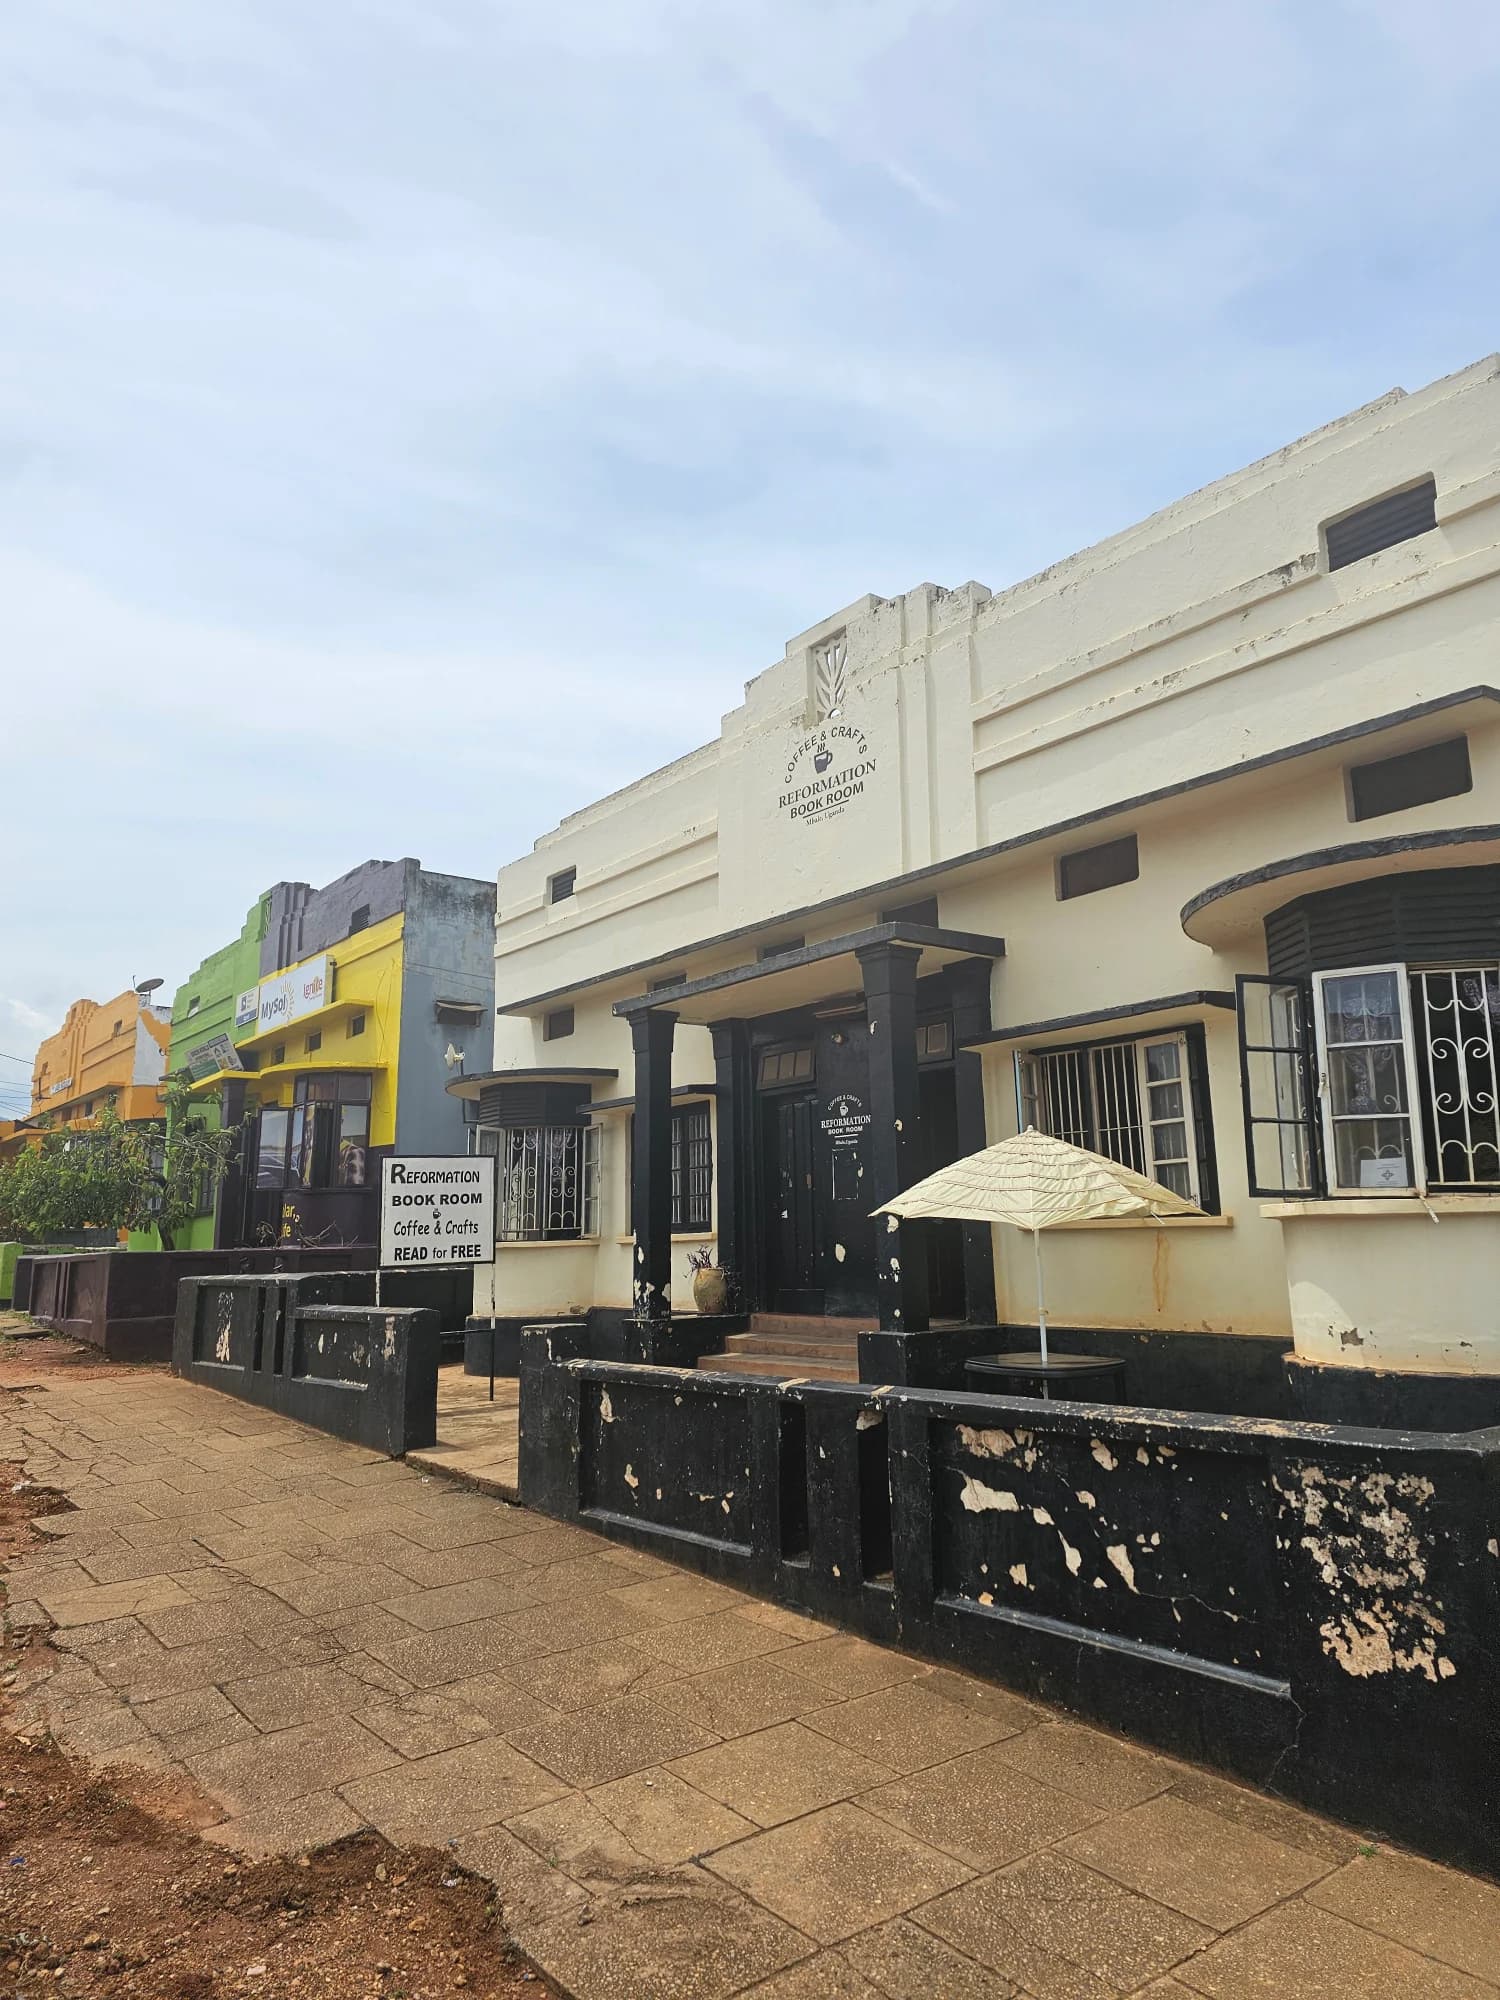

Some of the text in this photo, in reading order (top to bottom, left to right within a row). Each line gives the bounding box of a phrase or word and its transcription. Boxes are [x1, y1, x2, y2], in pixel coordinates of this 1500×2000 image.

[784, 726, 868, 784] COFFEE & CRAFTS
[779, 759, 877, 808] REFORMATION
[790, 781, 864, 819] BOOK ROOM
[261, 994, 287, 1020] MySol
[821, 1114, 871, 1128] REFORMATION
[846, 1125, 863, 1133] ROOM
[390, 1163, 480, 1184] REFORMATION
[392, 1193, 482, 1207] BOOK ROOM
[393, 1219, 479, 1236] Coffee & Crafts
[394, 1244, 482, 1261] READ for FREE
